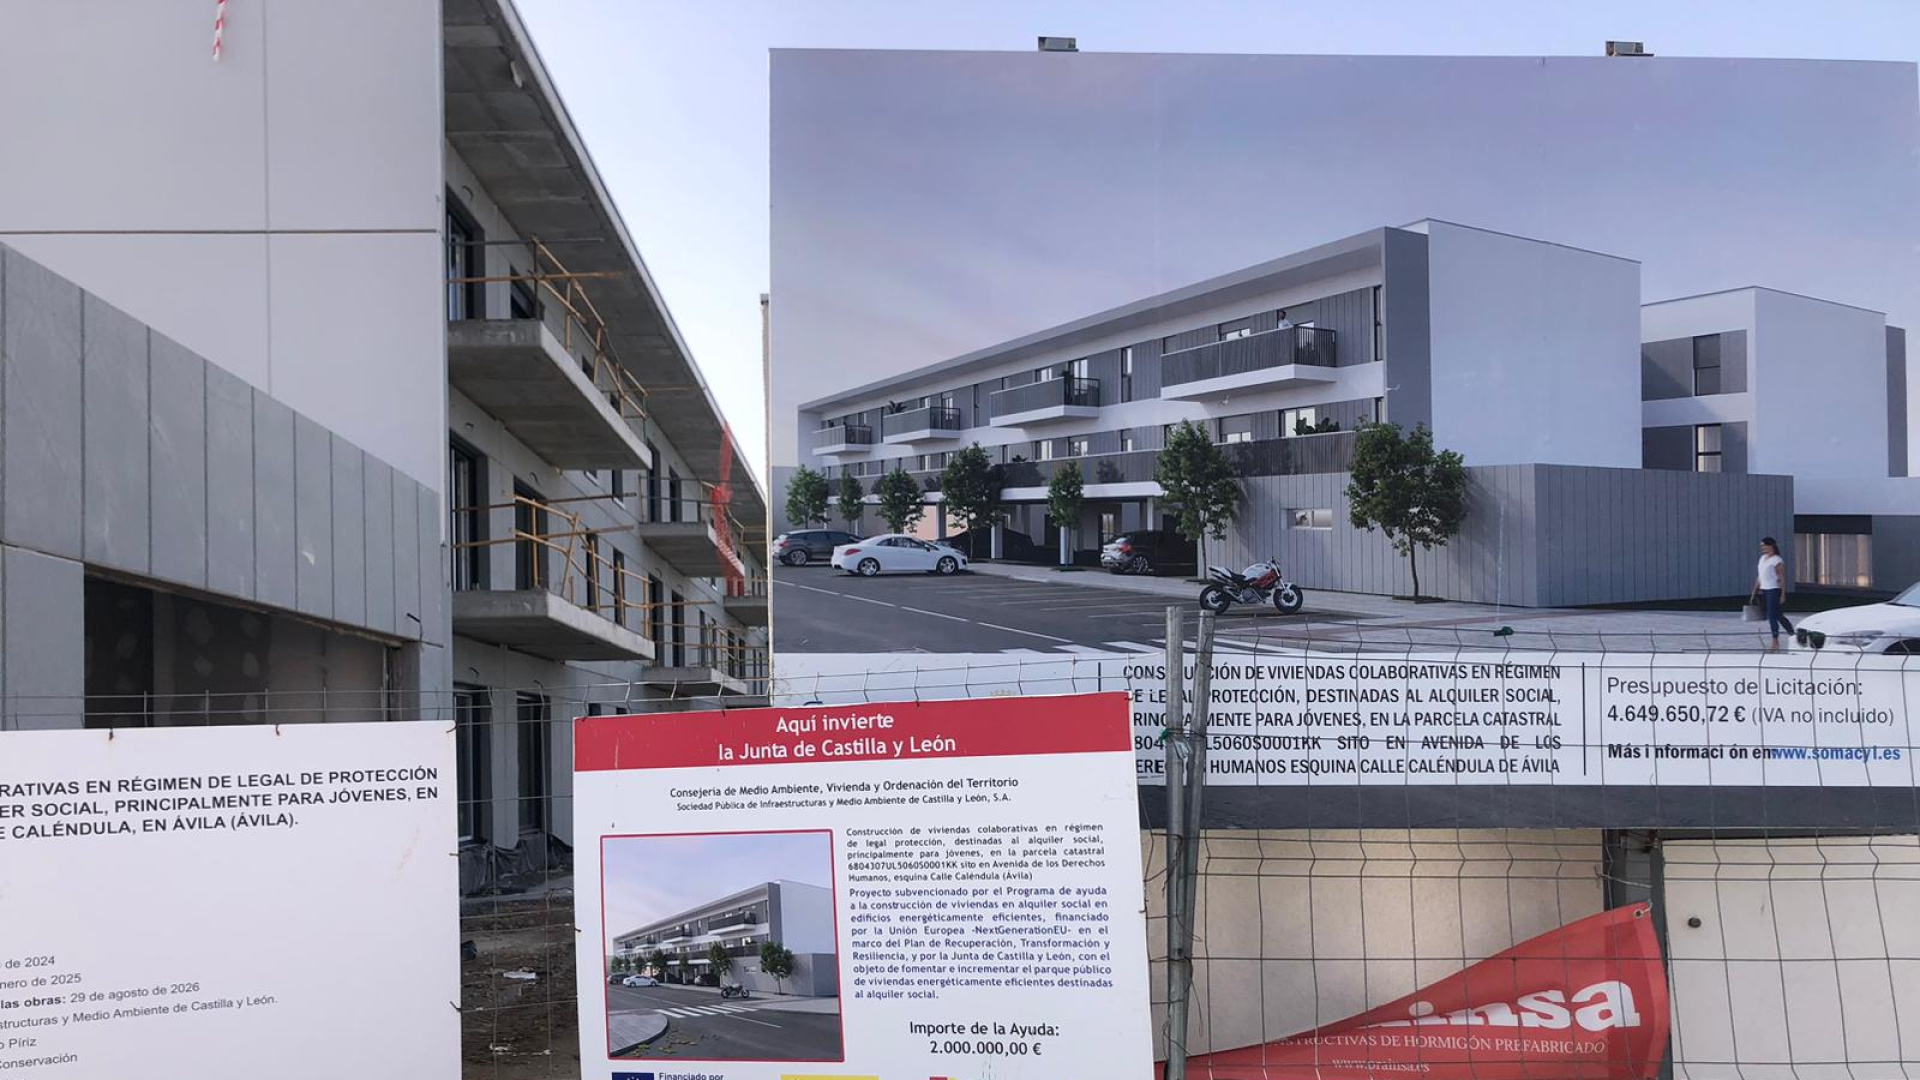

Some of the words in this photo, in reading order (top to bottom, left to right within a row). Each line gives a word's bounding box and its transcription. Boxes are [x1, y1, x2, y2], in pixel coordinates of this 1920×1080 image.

[1123, 662, 1240, 680] CONSUIÓN
[1245, 666, 1265, 680] DE
[1268, 664, 1345, 680] VIVIENDAS
[1349, 664, 1468, 680] COLABORATIVAS
[1472, 665, 1490, 679] EN
[1495, 661, 1561, 679] RÉGIMEN
[1607, 676, 1729, 697] Presupuesto
[1734, 677, 1758, 695] de
[1764, 677, 1863, 696] Licitación:
[1150, 689, 1194, 703] LEAL
[1209, 685, 1299, 705] ROTECCIÓN,
[1307, 688, 1399, 703] DESTINADAS
[1406, 688, 1423, 703] AL
[1428, 688, 1499, 705] ALQUILER
[1505, 688, 1561, 705] SOCIAL,
[1133, 712, 1252, 727] RINCAMENTE
[1256, 712, 1293, 727] PARA
[1297, 708, 1366, 727] JÓVENES,
[1371, 712, 1389, 726] EN
[1393, 712, 1410, 726] LA
[1415, 712, 1479, 726] PARCELA
[1482, 711, 1561, 726] CATASTRAL
[1607, 705, 1729, 724] 4.649.650,72
[1734, 705, 1746, 722] €
[1752, 707, 1785, 726] (IVA
[1791, 711, 1813, 723] no
[1818, 707, 1894, 726] incluido)
[775, 714, 816, 736] Aquí
[822, 713, 894, 730] invierte
[718, 743, 734, 760] la
[738, 742, 788, 759] Junta
[793, 740, 816, 757] de
[821, 737, 887, 756] Castilla
[892, 740, 903, 757] y
[910, 734, 956, 752] León
[1337, 735, 1370, 750] SITO
[1387, 735, 1405, 750] EN
[1422, 735, 1484, 750] AVENIDA
[1500, 735, 1520, 749] DE
[1535, 735, 1562, 750] LOS
[1607, 744, 1641, 759] Más
[1210, 759, 1287, 774] HUMANOS
[1291, 758, 1356, 775] ESQUINA
[1360, 758, 1404, 773] CALLE
[1408, 755, 1495, 773] CALÉNDULA
[1498, 759, 1518, 773] DE
[1521, 755, 1560, 773] ÁVILA
[0, 780, 80, 797] RATIVAS
[86, 780, 111, 794] EN
[117, 775, 202, 792] RÉGIMEN
[208, 775, 232, 788] DE
[237, 773, 295, 787] LEGAL
[300, 772, 323, 785] DE
[328, 765, 437, 784] PROTECCIÓN
[670, 787, 721, 799] Consejería
[739, 785, 769, 795] Medio
[770, 784, 823, 794] Ambiente,
[826, 781, 871, 792] Vivienda
[882, 779, 944, 791] Ordenación
[946, 778, 964, 789] del
[966, 777, 1019, 788] Territorio
[0, 804, 25, 818] ER
[31, 801, 108, 816] SOCIAL,
[114, 793, 272, 813] PRINCIPALMENTE
[278, 791, 324, 805] PARA
[328, 787, 411, 803] JÓVENES,
[416, 786, 438, 799] EN
[676, 802, 713, 811] Sociedad
[714, 801, 745, 810] Pública
[759, 799, 827, 808] Infraestructuras
[835, 797, 863, 806] Medio
[863, 796, 906, 805] Ambiente
[922, 794, 954, 803] Castilla
[964, 793, 990, 803] León,
[992, 792, 1011, 802] S.A.
[12, 820, 136, 839] CALÉNDULA,
[142, 818, 166, 832] EN
[172, 814, 226, 831] ÁVILA
[230, 812, 298, 830] (ÁVILA).
[845, 827, 903, 836] Construcción
[927, 825, 970, 834] viviendas
[977, 824, 1038, 833] colaborativas
[1064, 823, 1104, 833] régimen
[865, 839, 887, 849] legal
[894, 838, 945, 848] protección,
[954, 836, 1002, 846] destinadas
[1027, 835, 1064, 845] alquiler
[1072, 834, 1103, 844] social,
[846, 850, 914, 860] principalmente
[919, 850, 939, 859] para
[945, 849, 983, 859] jóvenes,
[1022, 847, 1057, 858] parcela
[1063, 846, 1104, 856] catastral
[960, 861, 976, 869] sito
[992, 859, 1029, 868] Avenida
[1061, 858, 1106, 867] Derechos
[848, 874, 891, 882] Humanos,
[893, 873, 928, 882] esquina
[929, 872, 953, 881] Calle
[954, 871, 1000, 881] Caléndula
[1002, 871, 1032, 881] (Ávila)
[849, 887, 892, 899] Proyecto
[894, 887, 968, 896] subvencionado
[1006, 886, 1055, 898] Programa
[1075, 886, 1107, 897] ayuda
[870, 900, 932, 910] construcción
[951, 899, 999, 909] viviendas
[1017, 899, 1057, 910] alquiler
[1061, 899, 1091, 908] social
[850, 912, 891, 922] edificios
[898, 912, 984, 924] energéticamente
[991, 911, 1046, 922] eficientes,
[1054, 911, 1109, 922] financiado
[888, 925, 918, 935] Unión
[923, 925, 965, 936] Europea
[971, 924, 1071, 935] -NextGenerationEU-
[4, 959, 21, 969] de
[24, 955, 55, 967] 2024
[30, 976, 47, 987] de
[50, 972, 82, 985] 2025
[868, 976, 915, 986] viviendas
[916, 976, 1002, 988] energéticamente
[1004, 977, 1055, 986] eficientes
[1056, 977, 1113, 988] destinadas
[0, 999, 20, 1009] las
[23, 996, 66, 1007] obras:
[70, 992, 86, 1003] 29
[108, 988, 149, 1001] agosto
[170, 982, 200, 994] 2026
[866, 989, 904, 1000] alquiler
[907, 989, 939, 999] social.
[72, 1010, 110, 1022] Medio
[112, 1005, 169, 1018] Ambiente
[190, 998, 234, 1011] Castilla
[246, 994, 277, 1006] León.
[910, 1020, 966, 1035] Importe
[970, 1021, 988, 1035] de
[993, 1021, 1006, 1035] la
[1009, 1022, 1059, 1038] Ayuda:
[8, 1037, 37, 1049] Píriz
[929, 1040, 1028, 1056] 2.000.000,00
[1032, 1042, 1041, 1055] €
[1380, 1035, 1400, 1047] DE
[1404, 1035, 1491, 1050] HORMIGÓN
[1496, 1038, 1605, 1054] PREFABRICADO
[658, 1072, 707, 1080] Financiado
